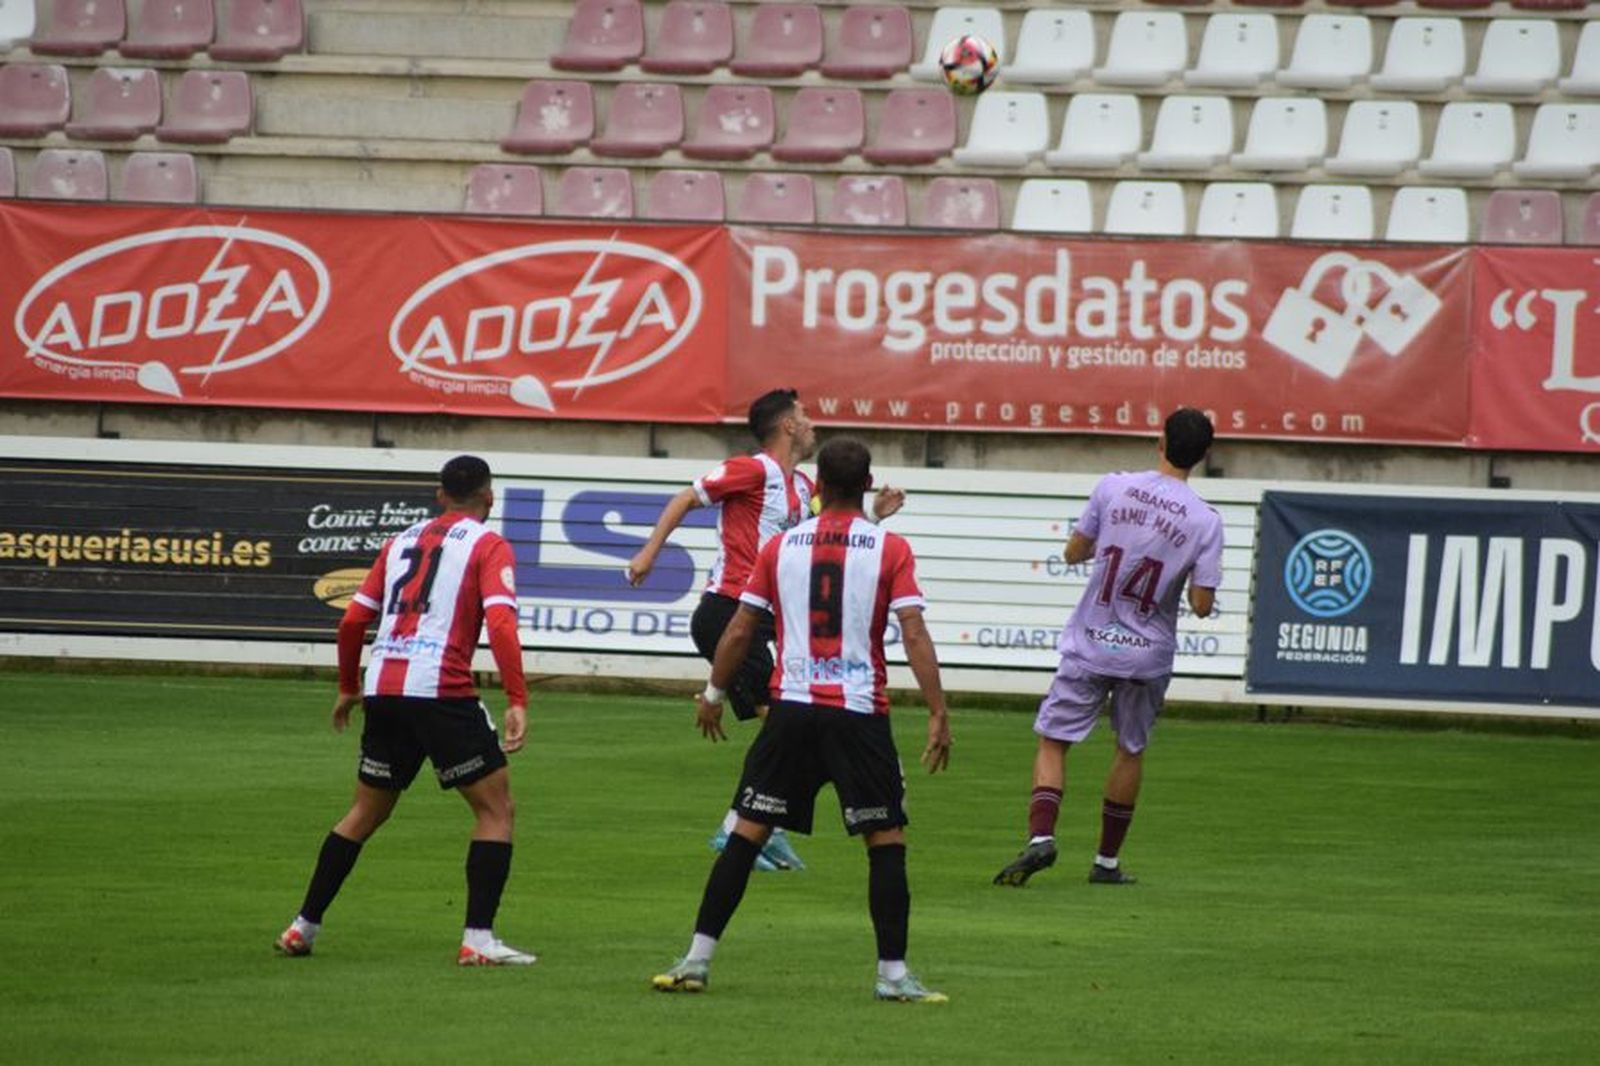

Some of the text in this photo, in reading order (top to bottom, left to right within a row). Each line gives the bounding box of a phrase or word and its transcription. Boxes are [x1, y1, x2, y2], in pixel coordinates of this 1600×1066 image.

[26, 265, 304, 357] ADOZA
[751, 245, 1249, 353] Progesdatos
[400, 278, 677, 372] ADOZA
[930, 338, 1247, 369] protección y gestión de datos
[818, 398, 1364, 432] www.progesdas.com
[307, 502, 429, 529] Come bien
[1130, 488, 1188, 518] ABANCA
[298, 534, 362, 553] come
[816, 531, 876, 549] CAMACHO
[1111, 508, 1148, 527] SAMU
[1153, 516, 1188, 549] MAYO
[0, 528, 271, 568] asqueriasusi.es
[387, 547, 444, 615] 21
[1095, 544, 1164, 617] 14
[810, 561, 844, 639] 9
[1400, 533, 1600, 673] IMP
[516, 606, 690, 638] HIJO DE
[977, 627, 1061, 650] CUART
[1277, 622, 1369, 652] SEGUNDA
[1276, 651, 1366, 664] FEDERACIÓN
